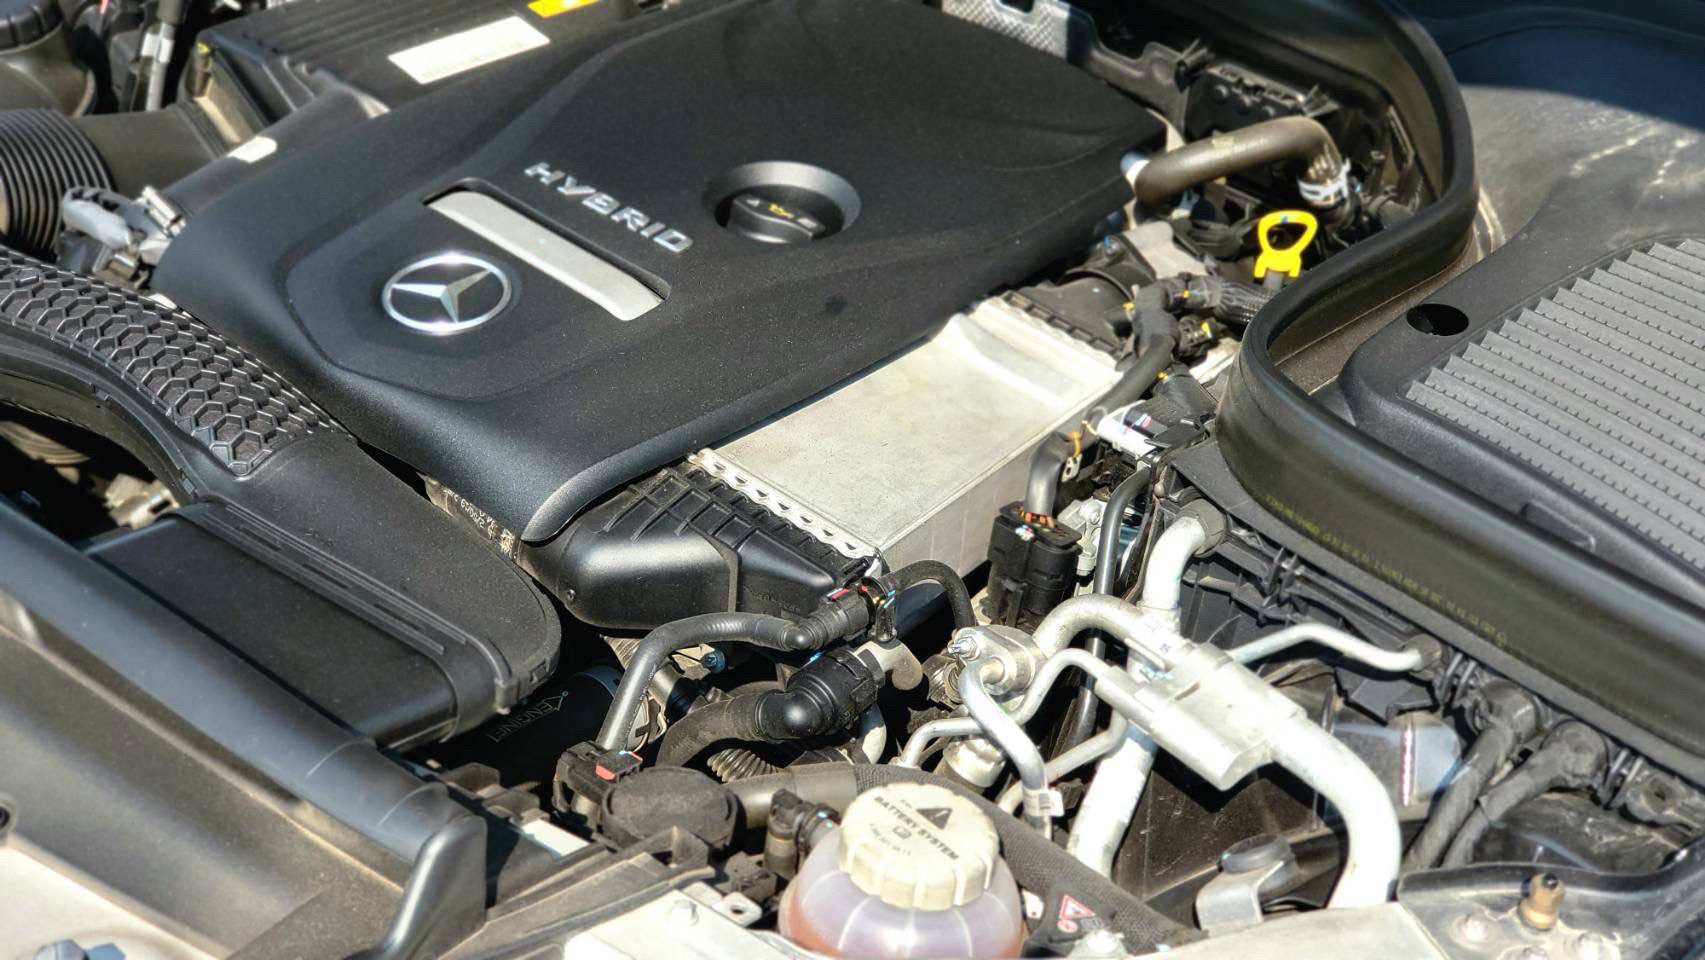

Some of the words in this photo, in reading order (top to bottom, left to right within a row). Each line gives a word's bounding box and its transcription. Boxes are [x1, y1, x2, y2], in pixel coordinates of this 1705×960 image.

[524, 162, 694, 254] HYBRID
[873, 796, 918, 829] BATTERY
[918, 829, 959, 860] SYSTEM
